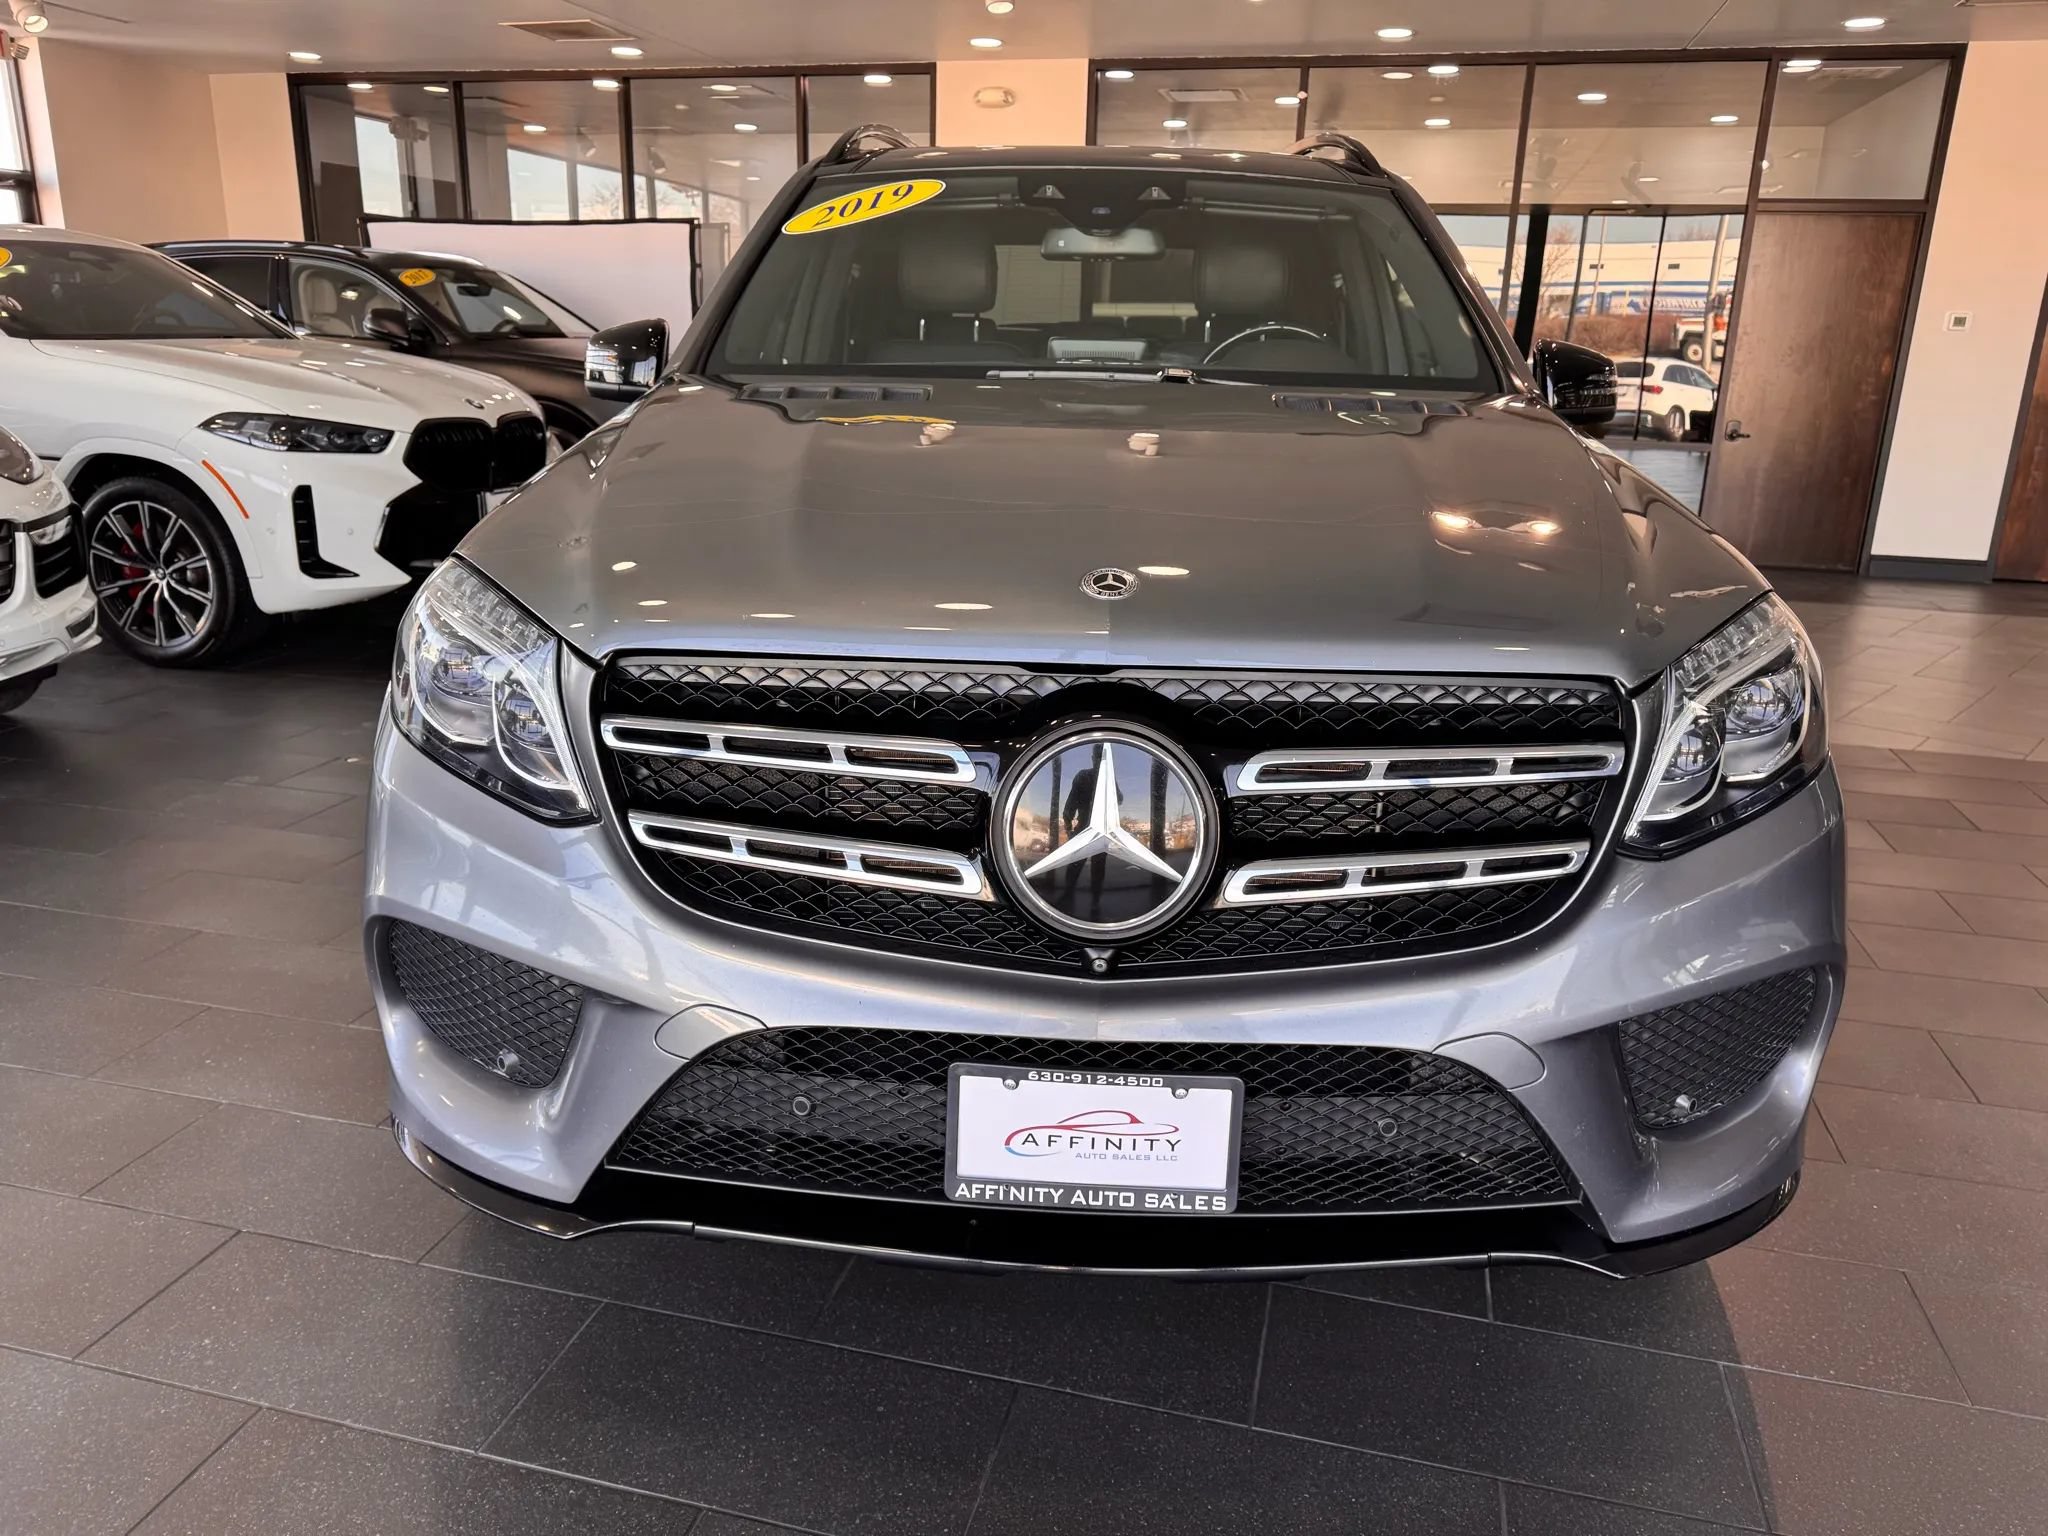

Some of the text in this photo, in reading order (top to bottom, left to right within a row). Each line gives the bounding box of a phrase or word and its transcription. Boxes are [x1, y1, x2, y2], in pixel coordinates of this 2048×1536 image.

[811, 184, 914, 228] 2019
[1028, 1070, 1164, 1088] 630-912-4500
[1021, 1132, 1182, 1152] AFFINITY
[1075, 1152, 1178, 1162] AUTO SALES LLC
[954, 1183, 1227, 1212] AFFINITY AUTO SALES
